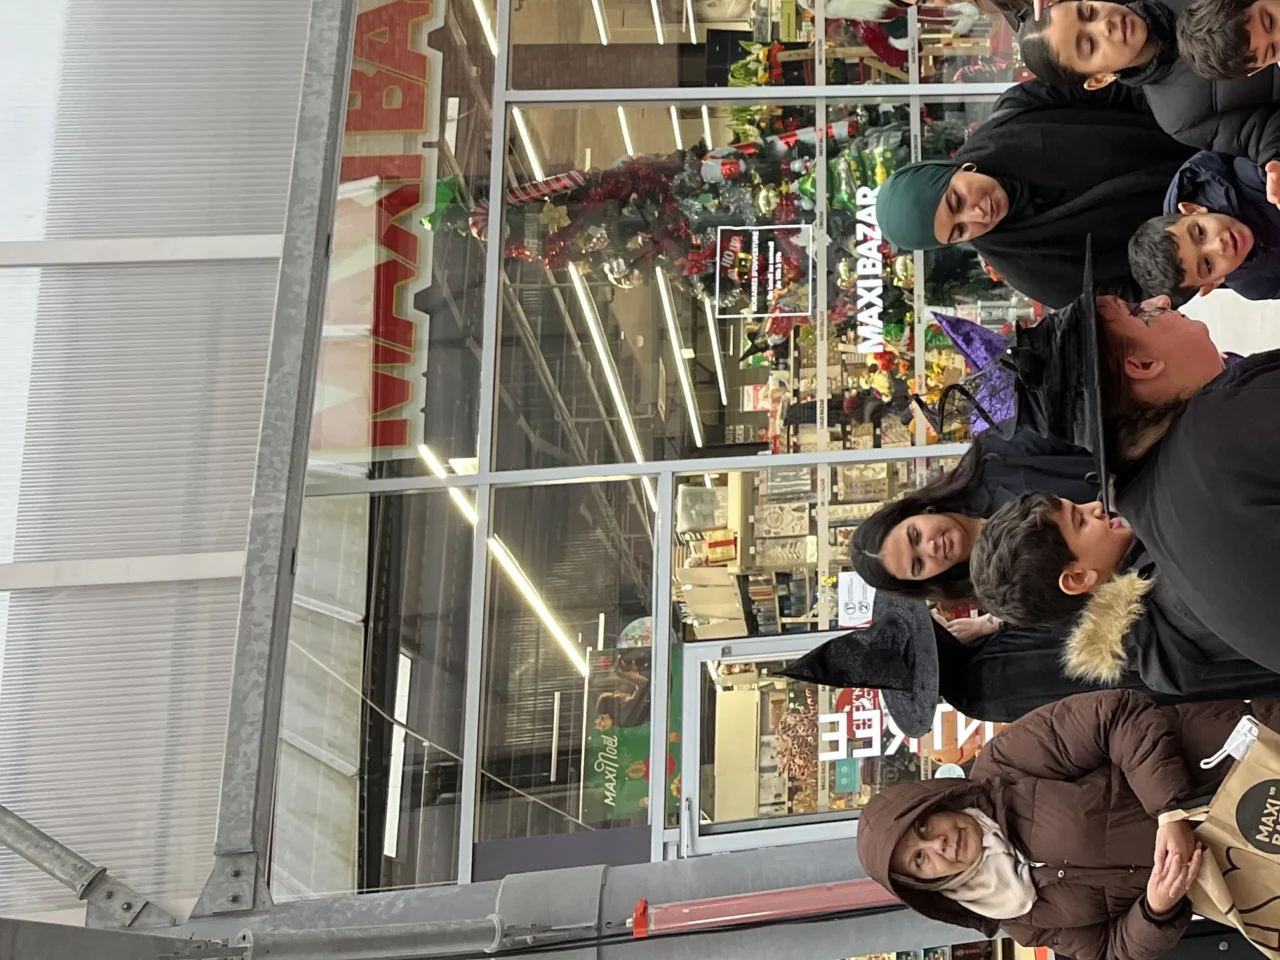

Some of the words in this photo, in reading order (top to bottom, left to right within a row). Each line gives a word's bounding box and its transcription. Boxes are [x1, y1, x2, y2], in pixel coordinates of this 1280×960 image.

[855, 185, 883, 275] BAZAR
[309, 154, 424, 450] MAXI
[856, 279, 884, 354] MAXI
[852, 688, 863, 732] CLCK'N
[594, 735, 619, 772] Noël
[603, 767, 617, 806] MAXI
